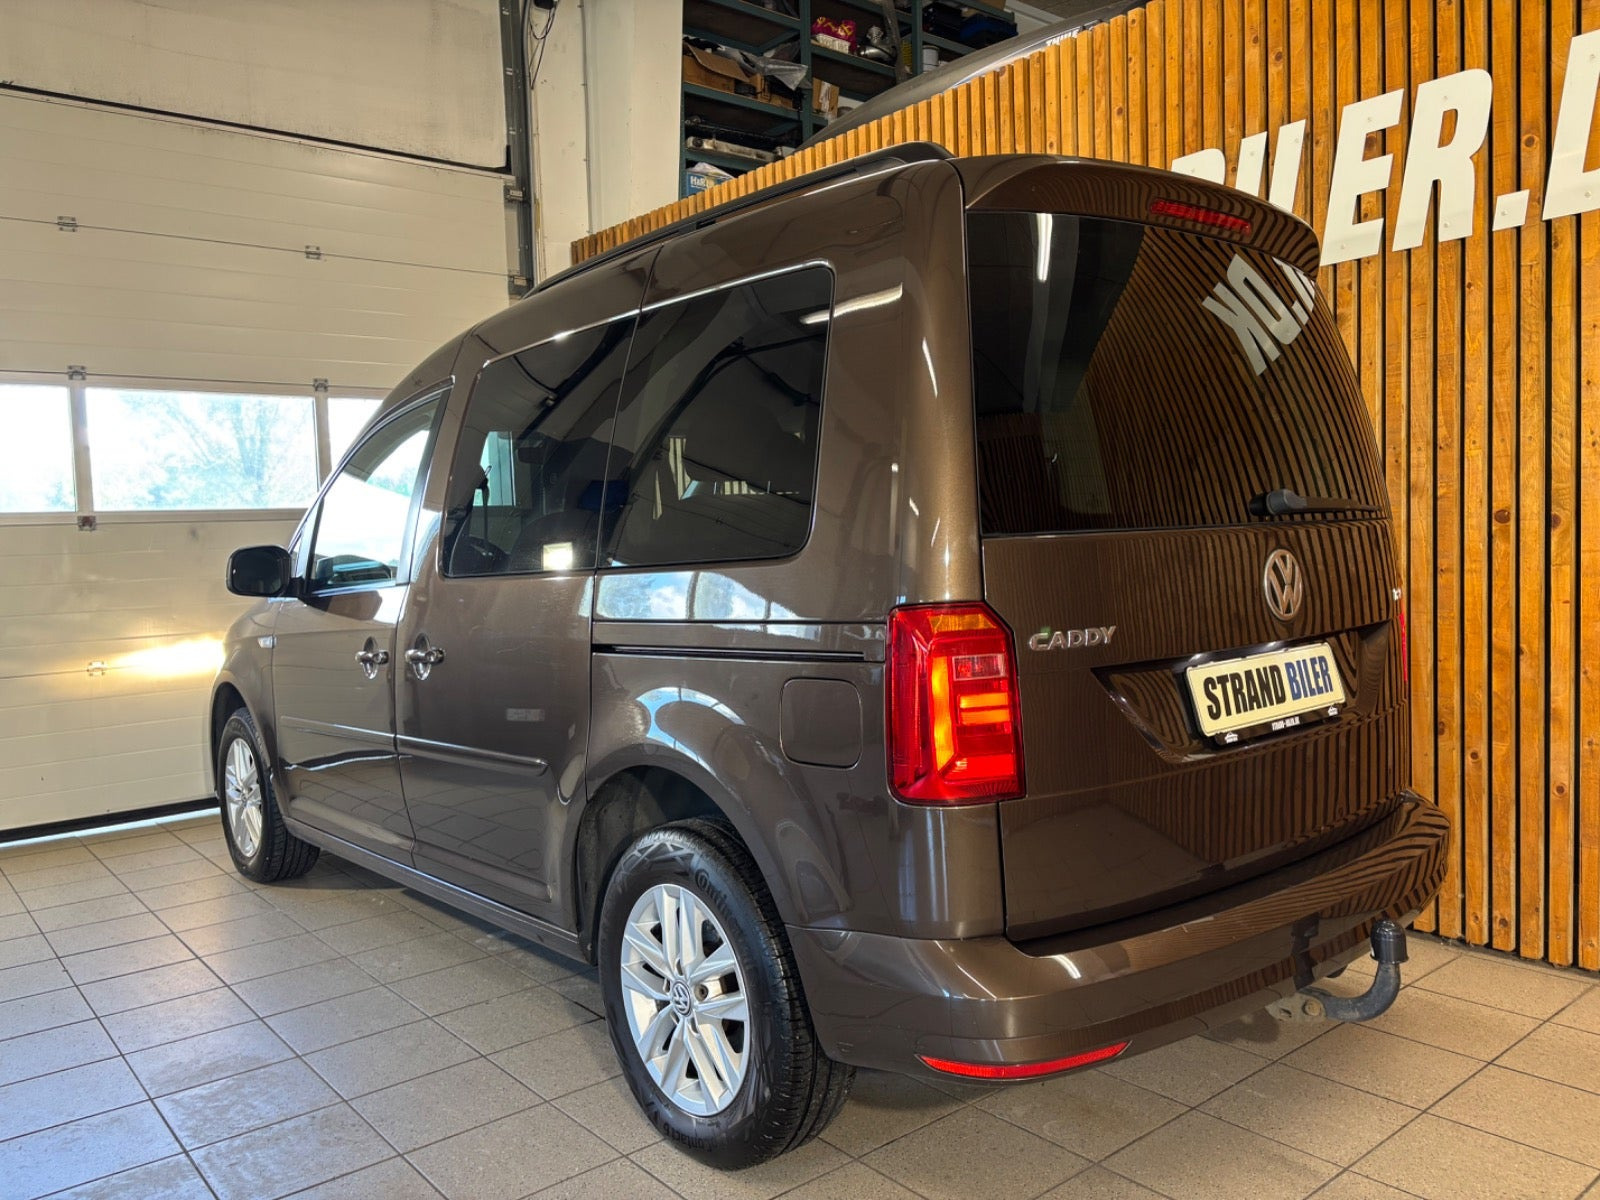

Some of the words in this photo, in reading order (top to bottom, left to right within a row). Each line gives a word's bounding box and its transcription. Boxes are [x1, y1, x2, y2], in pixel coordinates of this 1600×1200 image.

[1028, 625, 1117, 652] CADDY
[1203, 664, 1286, 720] STRAND
[1284, 655, 1333, 701] BILER
